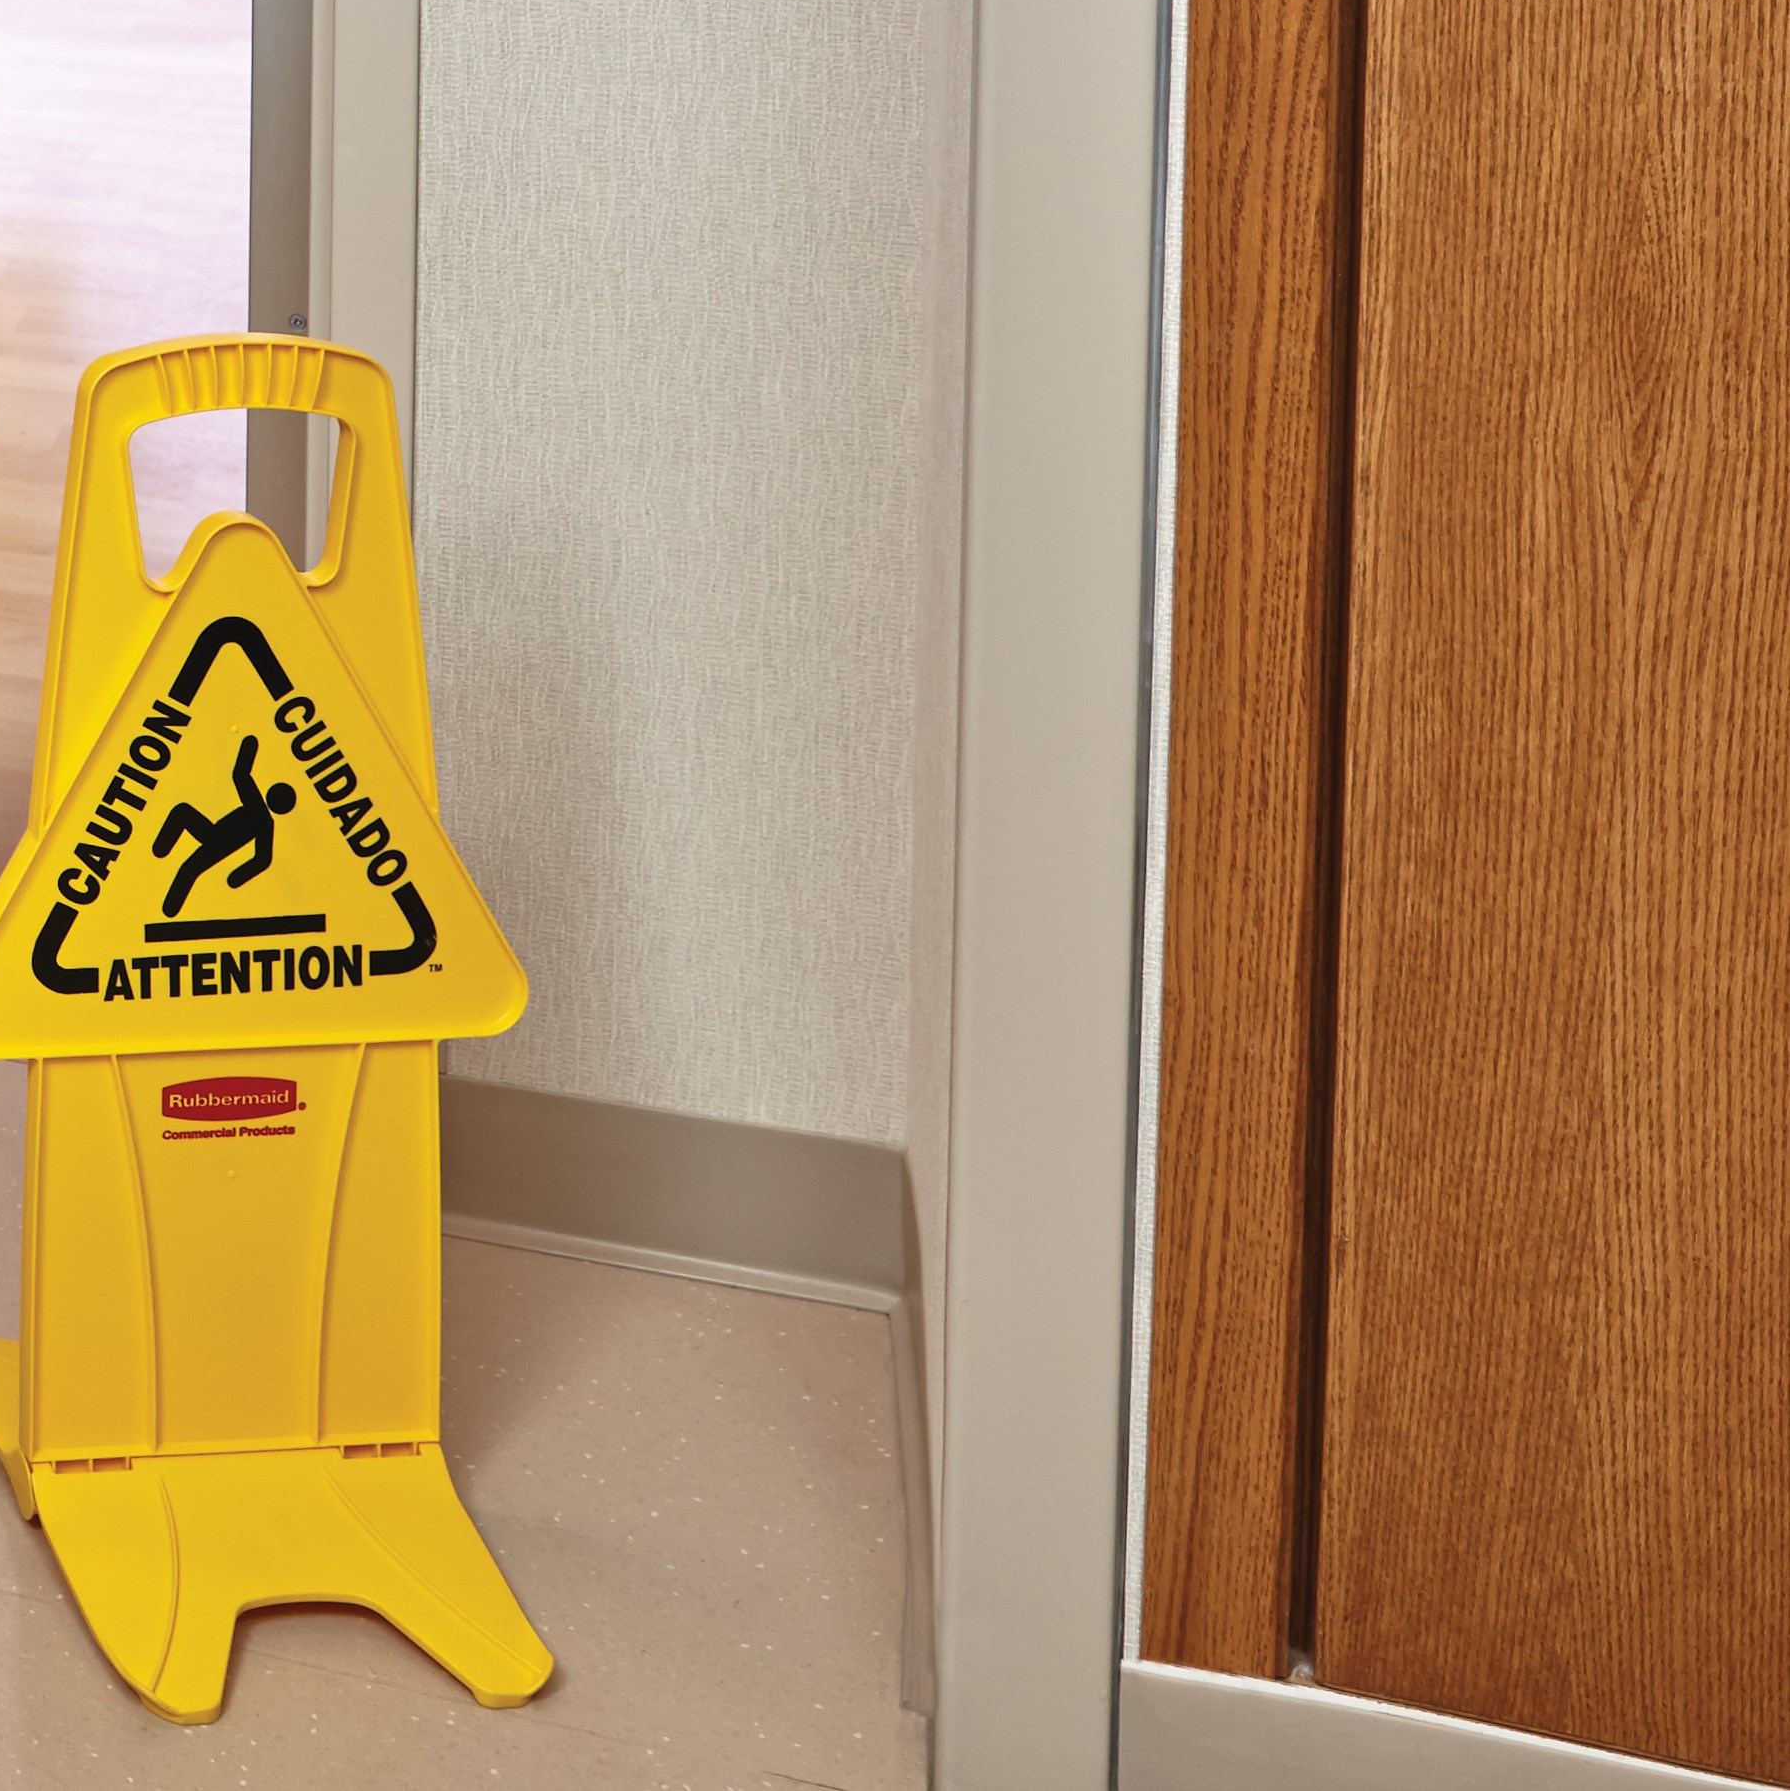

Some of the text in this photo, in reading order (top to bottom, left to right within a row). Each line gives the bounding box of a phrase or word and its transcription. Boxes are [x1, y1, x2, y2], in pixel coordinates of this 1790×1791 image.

[57, 699, 192, 905] CAUTION
[274, 696, 408, 887] CUIDADO
[103, 945, 363, 1002] ATTENTION
[168, 1090, 290, 1108] Rubbermaid
[162, 1124, 296, 1140] Commercial Products
